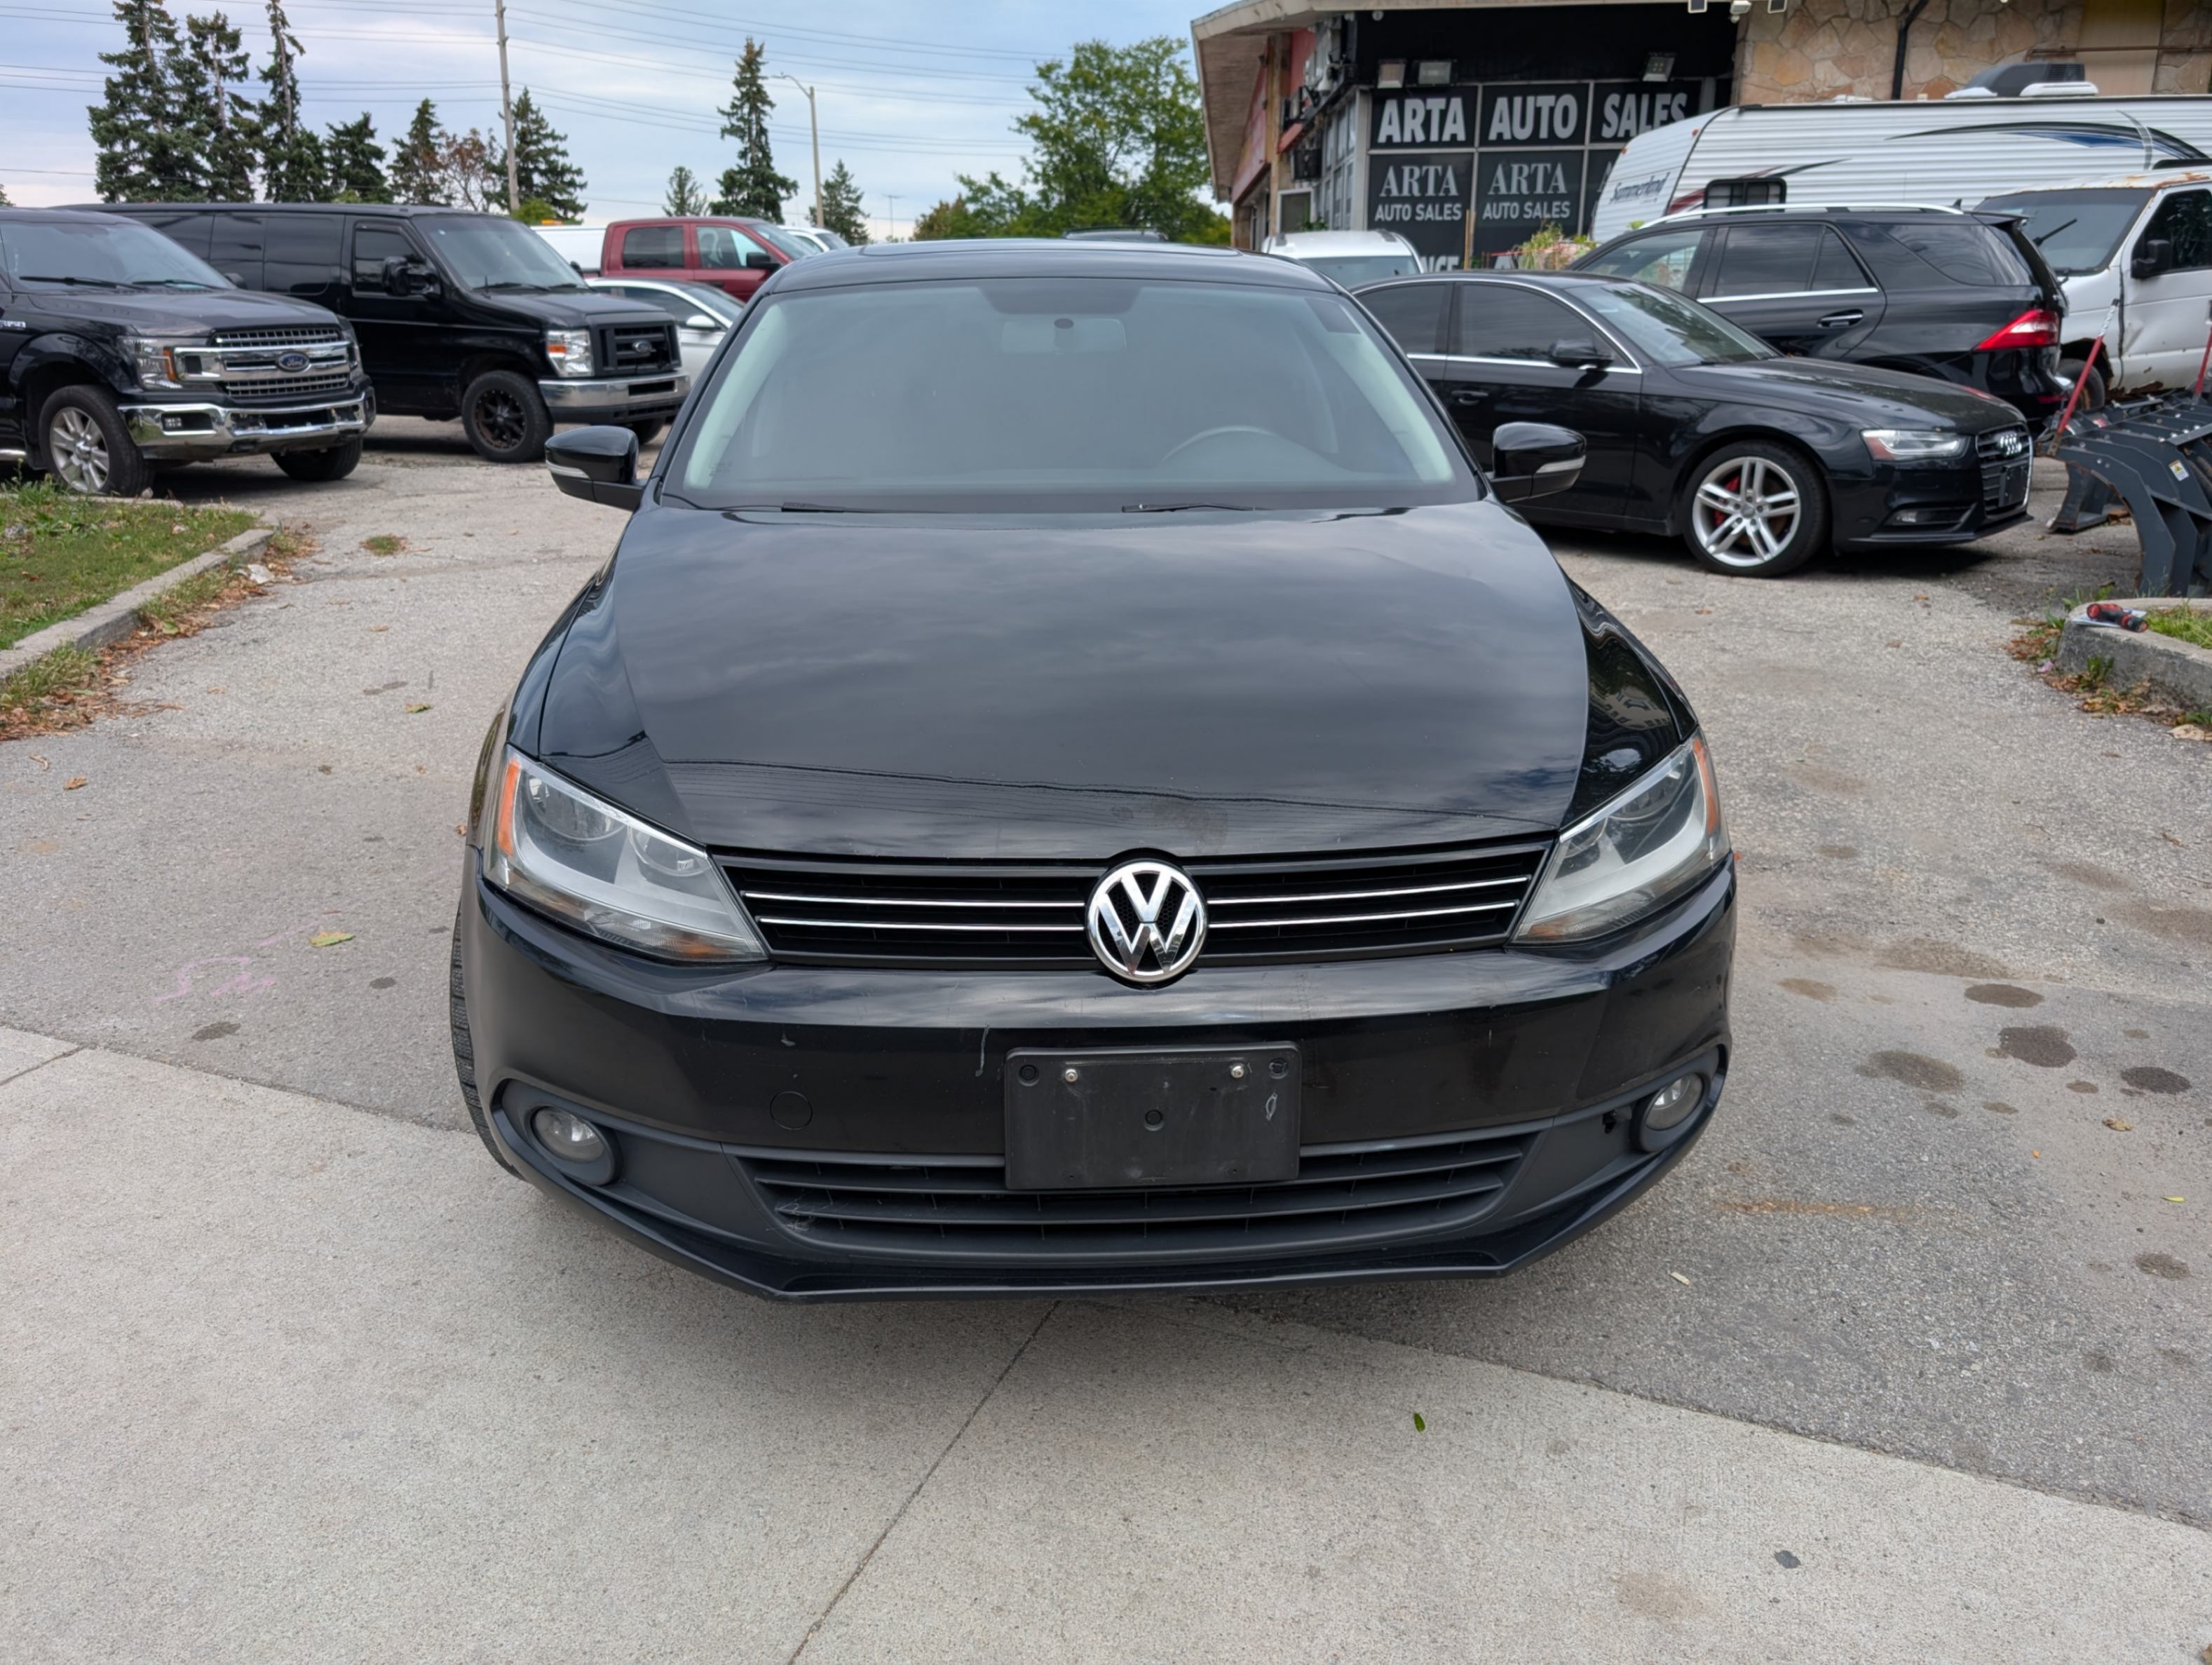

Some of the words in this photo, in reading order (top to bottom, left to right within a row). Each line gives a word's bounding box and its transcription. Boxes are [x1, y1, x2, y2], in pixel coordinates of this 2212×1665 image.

[1377, 97, 1466, 143] ARTA
[1488, 93, 1578, 141] AUTO
[1601, 92, 1688, 139] SALES
[1379, 165, 1459, 198] ARTA
[1487, 162, 1568, 196] ARTA
[1374, 203, 1412, 222] AUTO
[1415, 203, 1463, 221] SALES
[1482, 201, 1520, 220] AUTO
[1523, 201, 1570, 219] SALES
